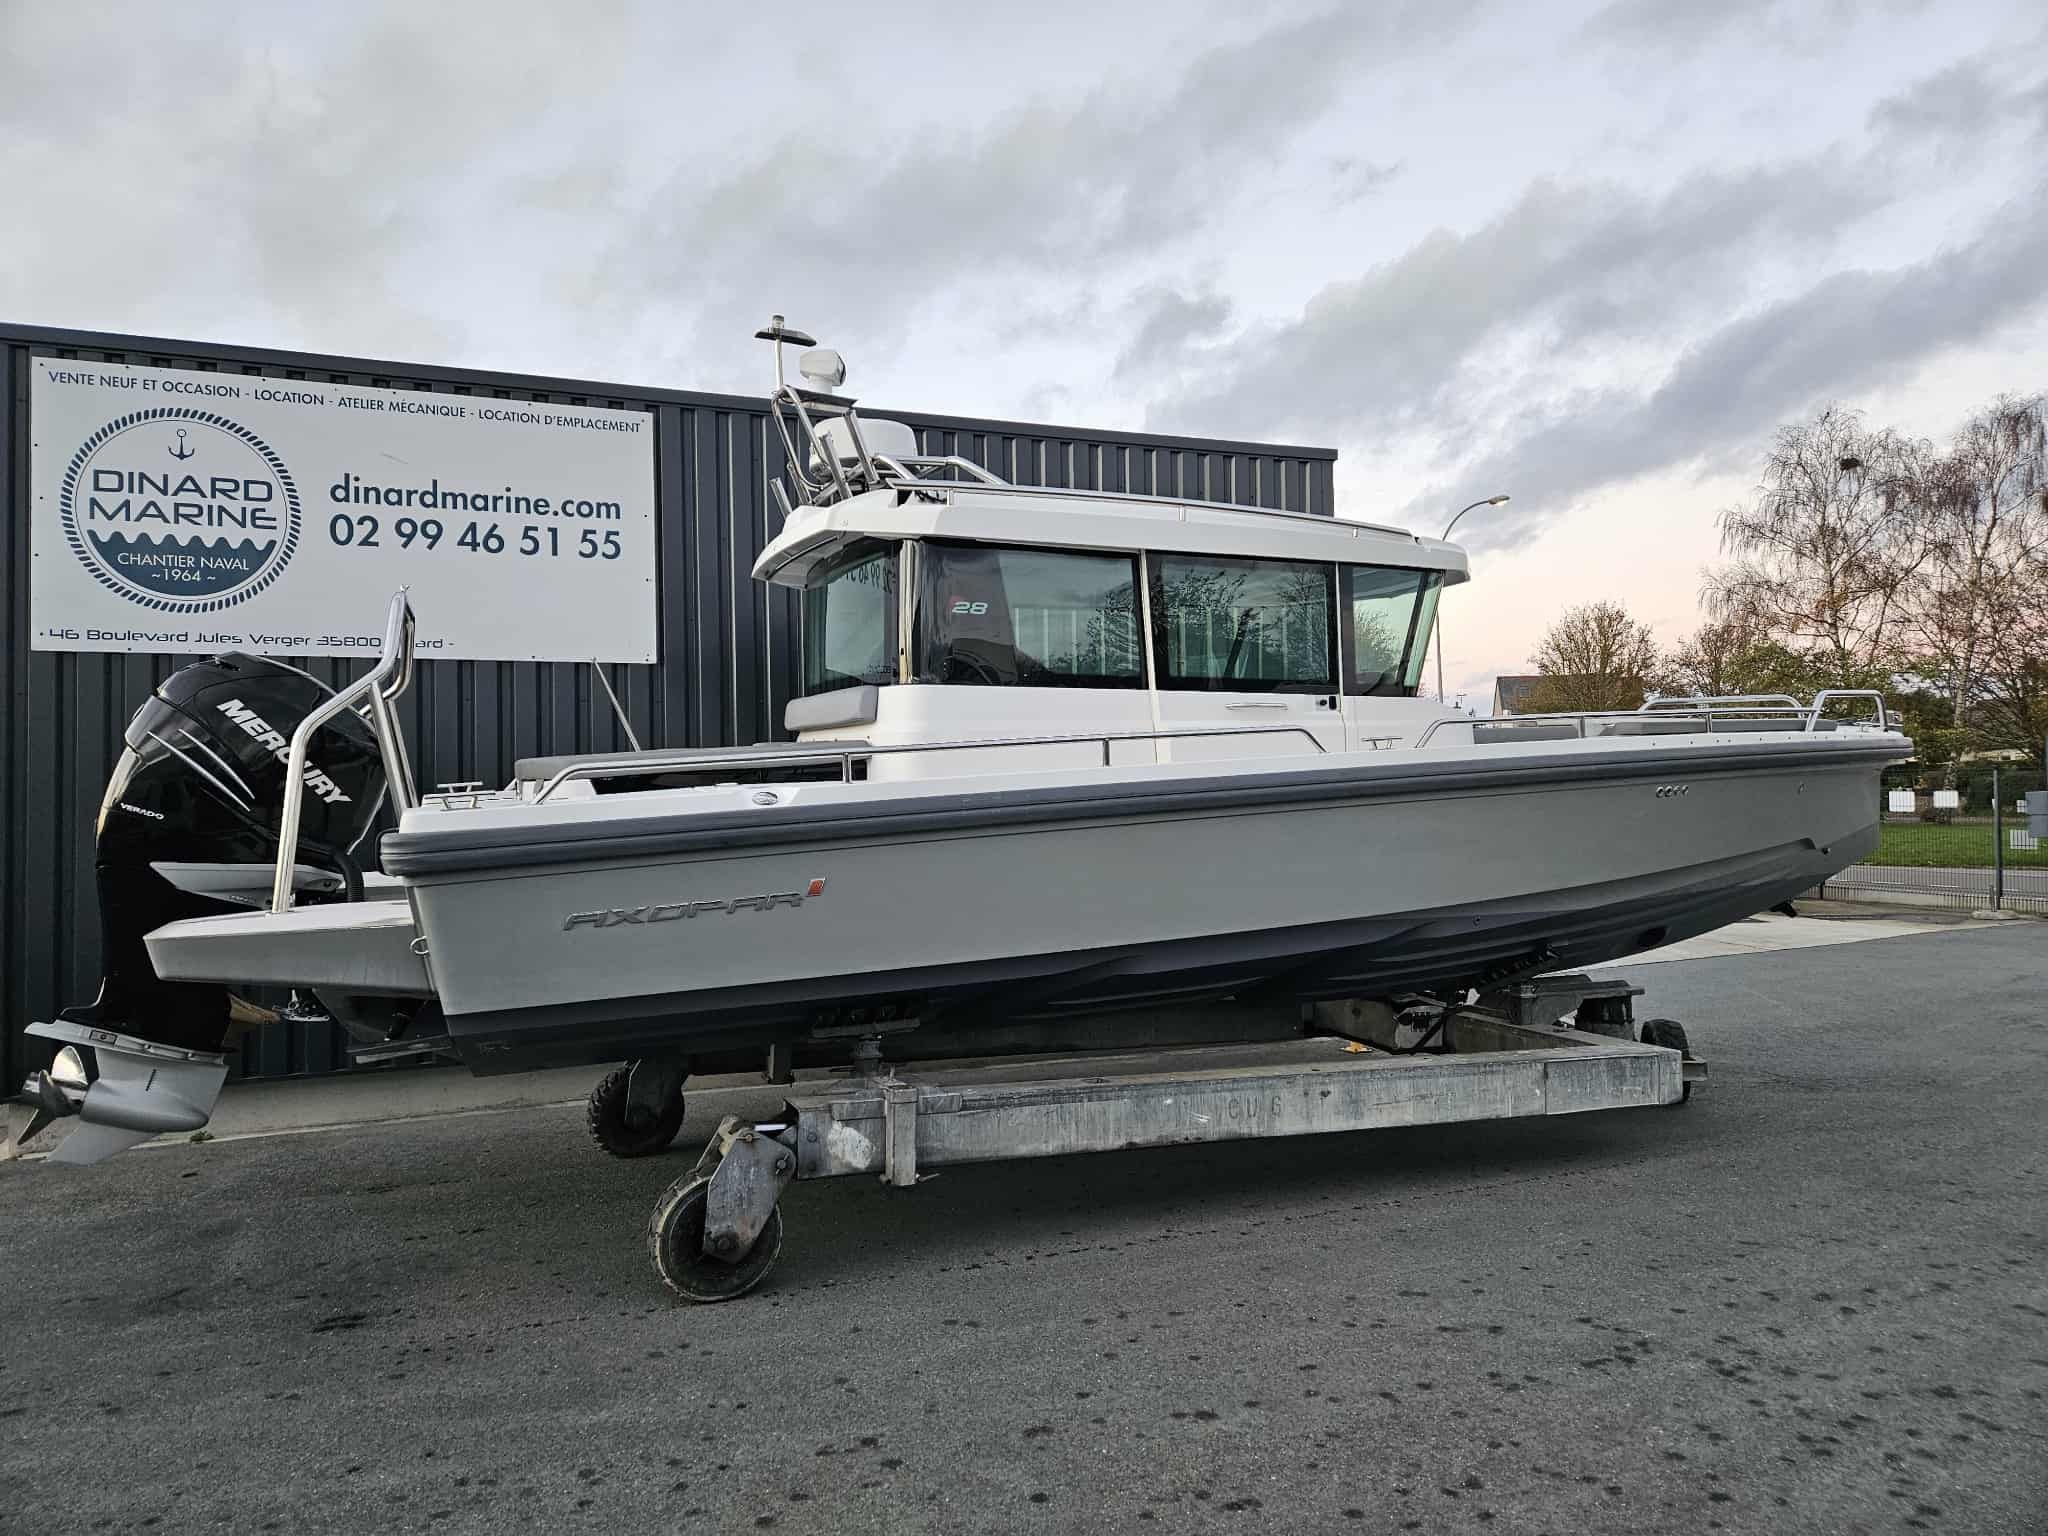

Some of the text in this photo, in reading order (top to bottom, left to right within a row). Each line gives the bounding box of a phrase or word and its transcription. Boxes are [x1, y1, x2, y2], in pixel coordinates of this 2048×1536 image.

[48, 371, 95, 386] VENTE
[100, 376, 138, 389] NEUF
[143, 379, 158, 391] ET
[162, 381, 240, 398] OCCASION
[254, 389, 324, 406] LOCATION
[337, 397, 384, 411] ATELIER
[479, 408, 540, 425] LOCATION
[93, 469, 273, 502] DINARD
[330, 473, 621, 519] dinardmarine.com
[89, 497, 278, 530] MARINE
[329, 513, 622, 560] 02 99 46 51 55
[117, 552, 249, 570] CHANTIER NAVAL
[951, 601, 988, 615] 28
[49, 629, 80, 640] 46
[87, 629, 188, 643] Boulevard
[194, 632, 243, 644] Jules
[249, 633, 309, 647] Verger
[316, 636, 382, 648] 35800
[120, 802, 165, 820] VERADO
[563, 891, 803, 931] AXOPAR
